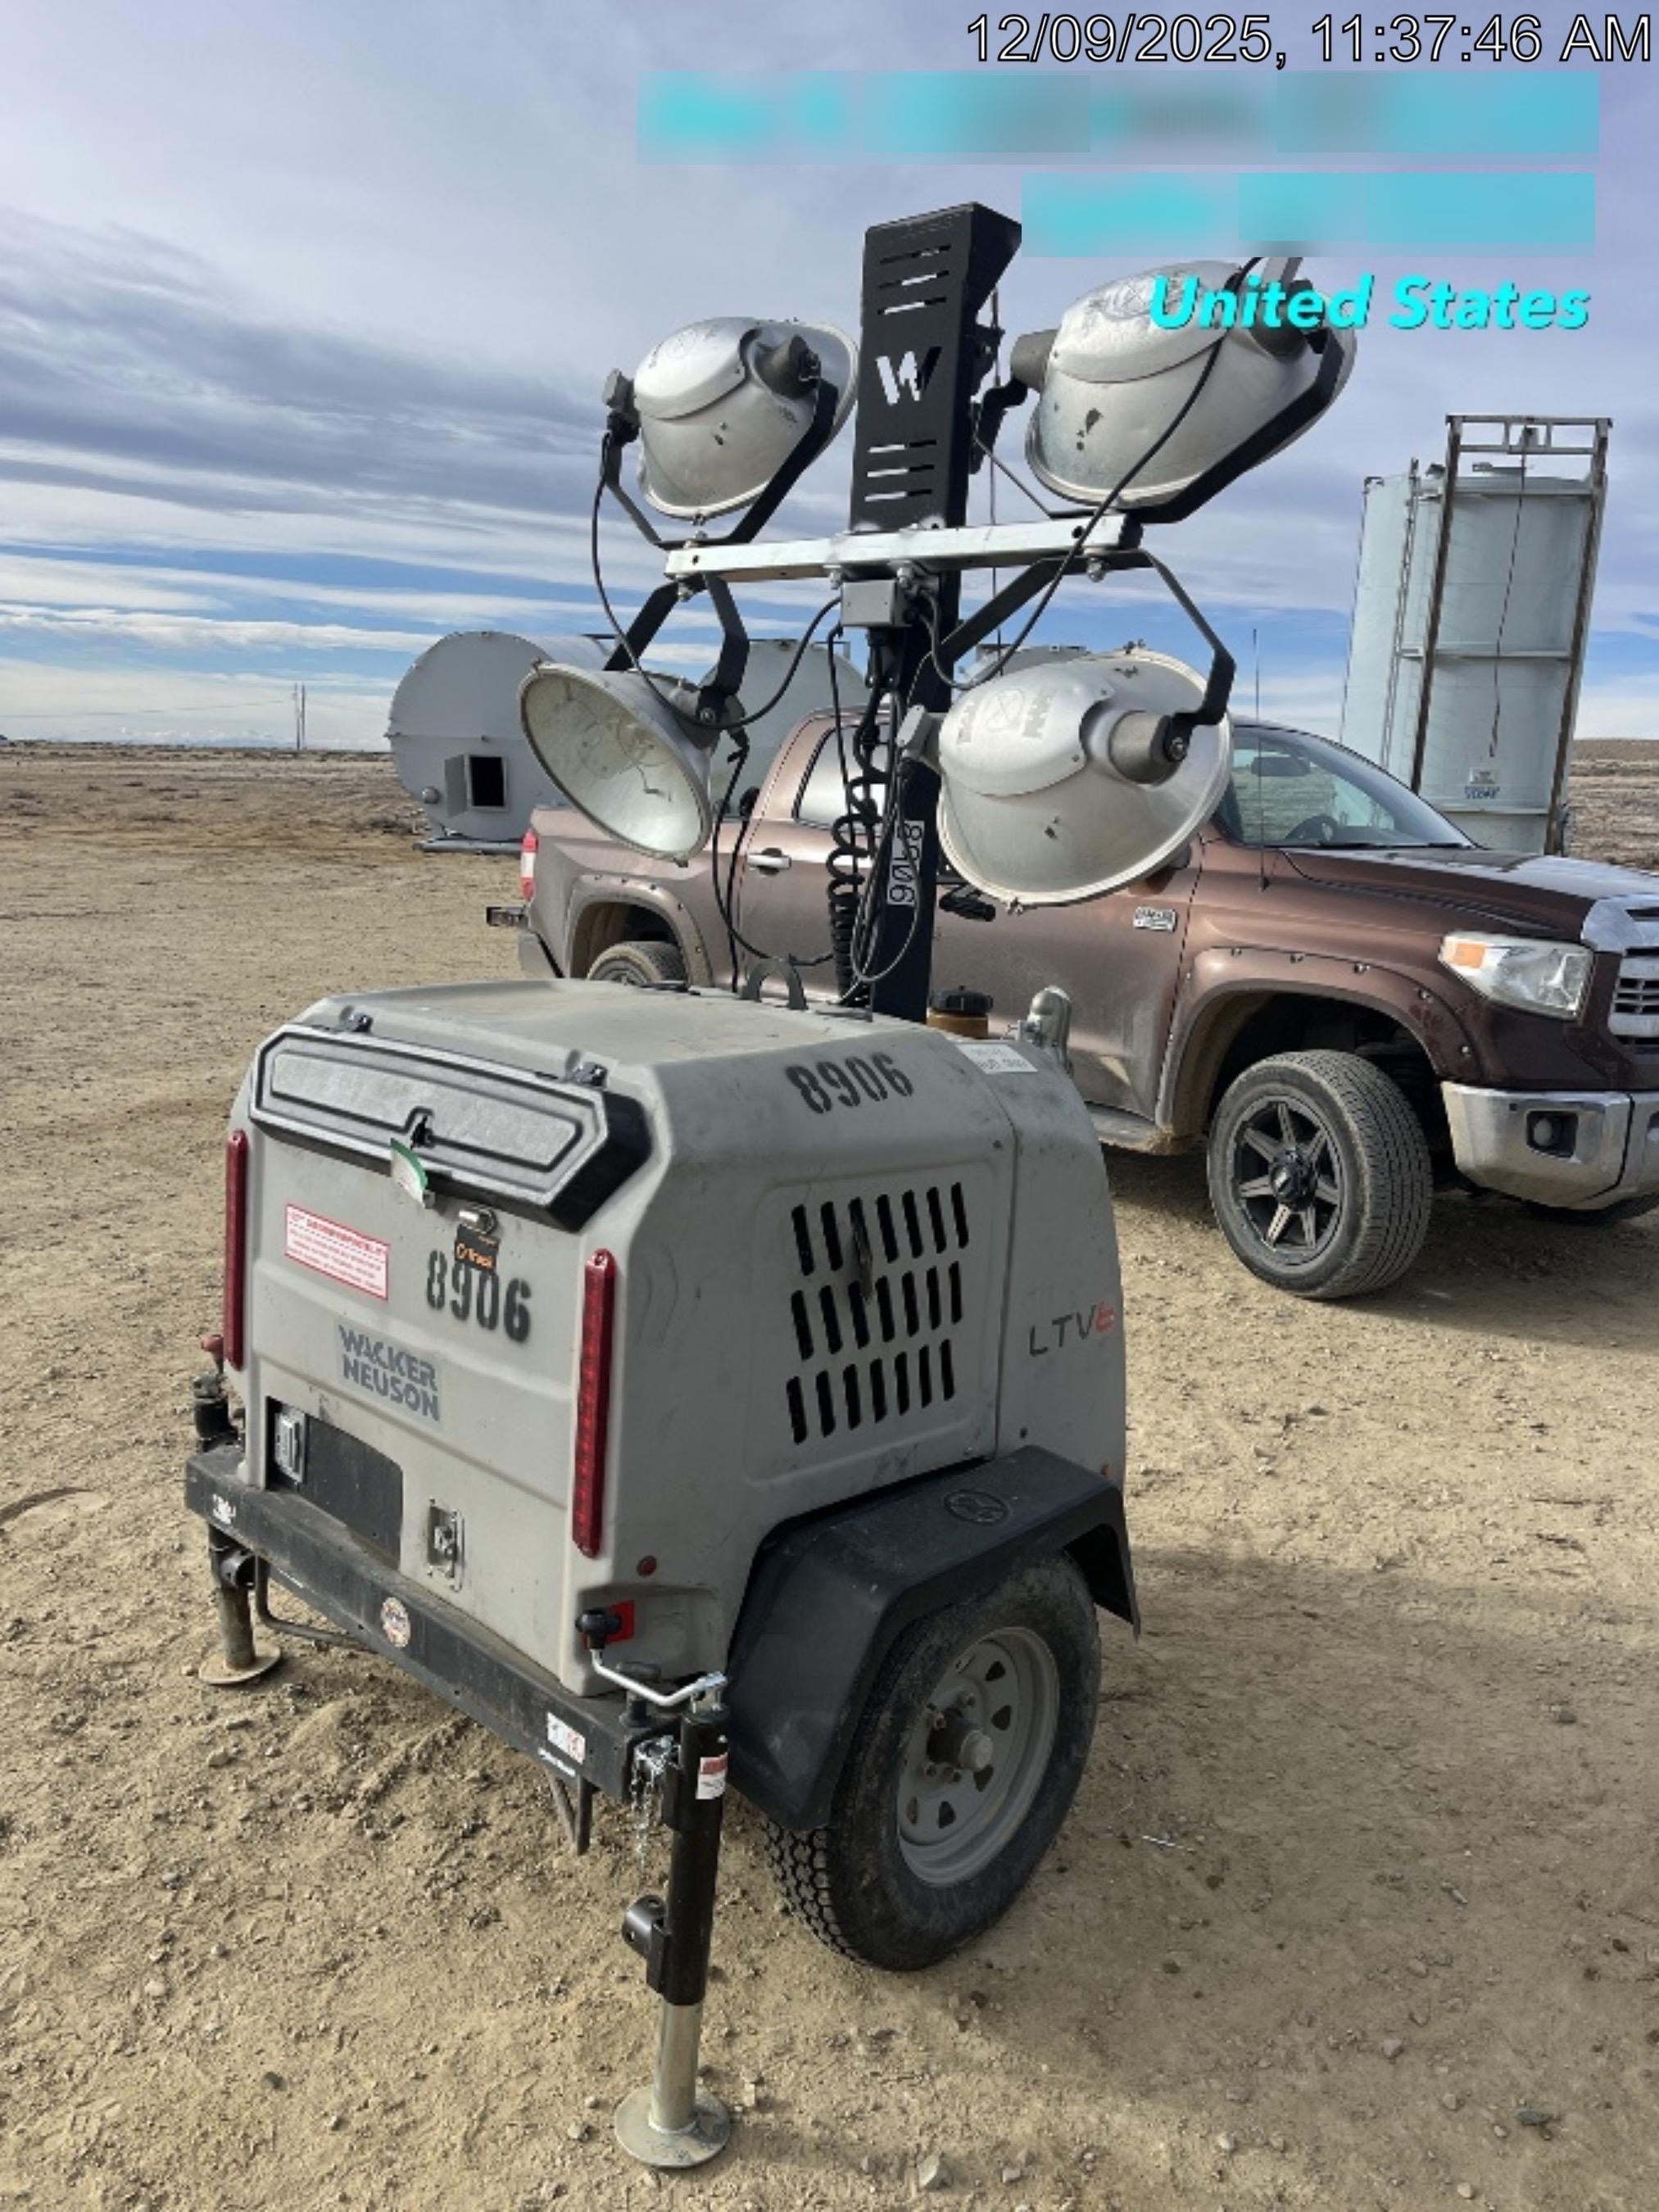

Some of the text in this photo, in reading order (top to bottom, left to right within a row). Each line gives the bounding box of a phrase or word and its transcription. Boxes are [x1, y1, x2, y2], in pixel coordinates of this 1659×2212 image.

[785, 1051, 914, 1115] 8906
[426, 1249, 532, 1344] 8906
[338, 1324, 438, 1392] WACKER
[343, 1353, 440, 1422] NEUSON
